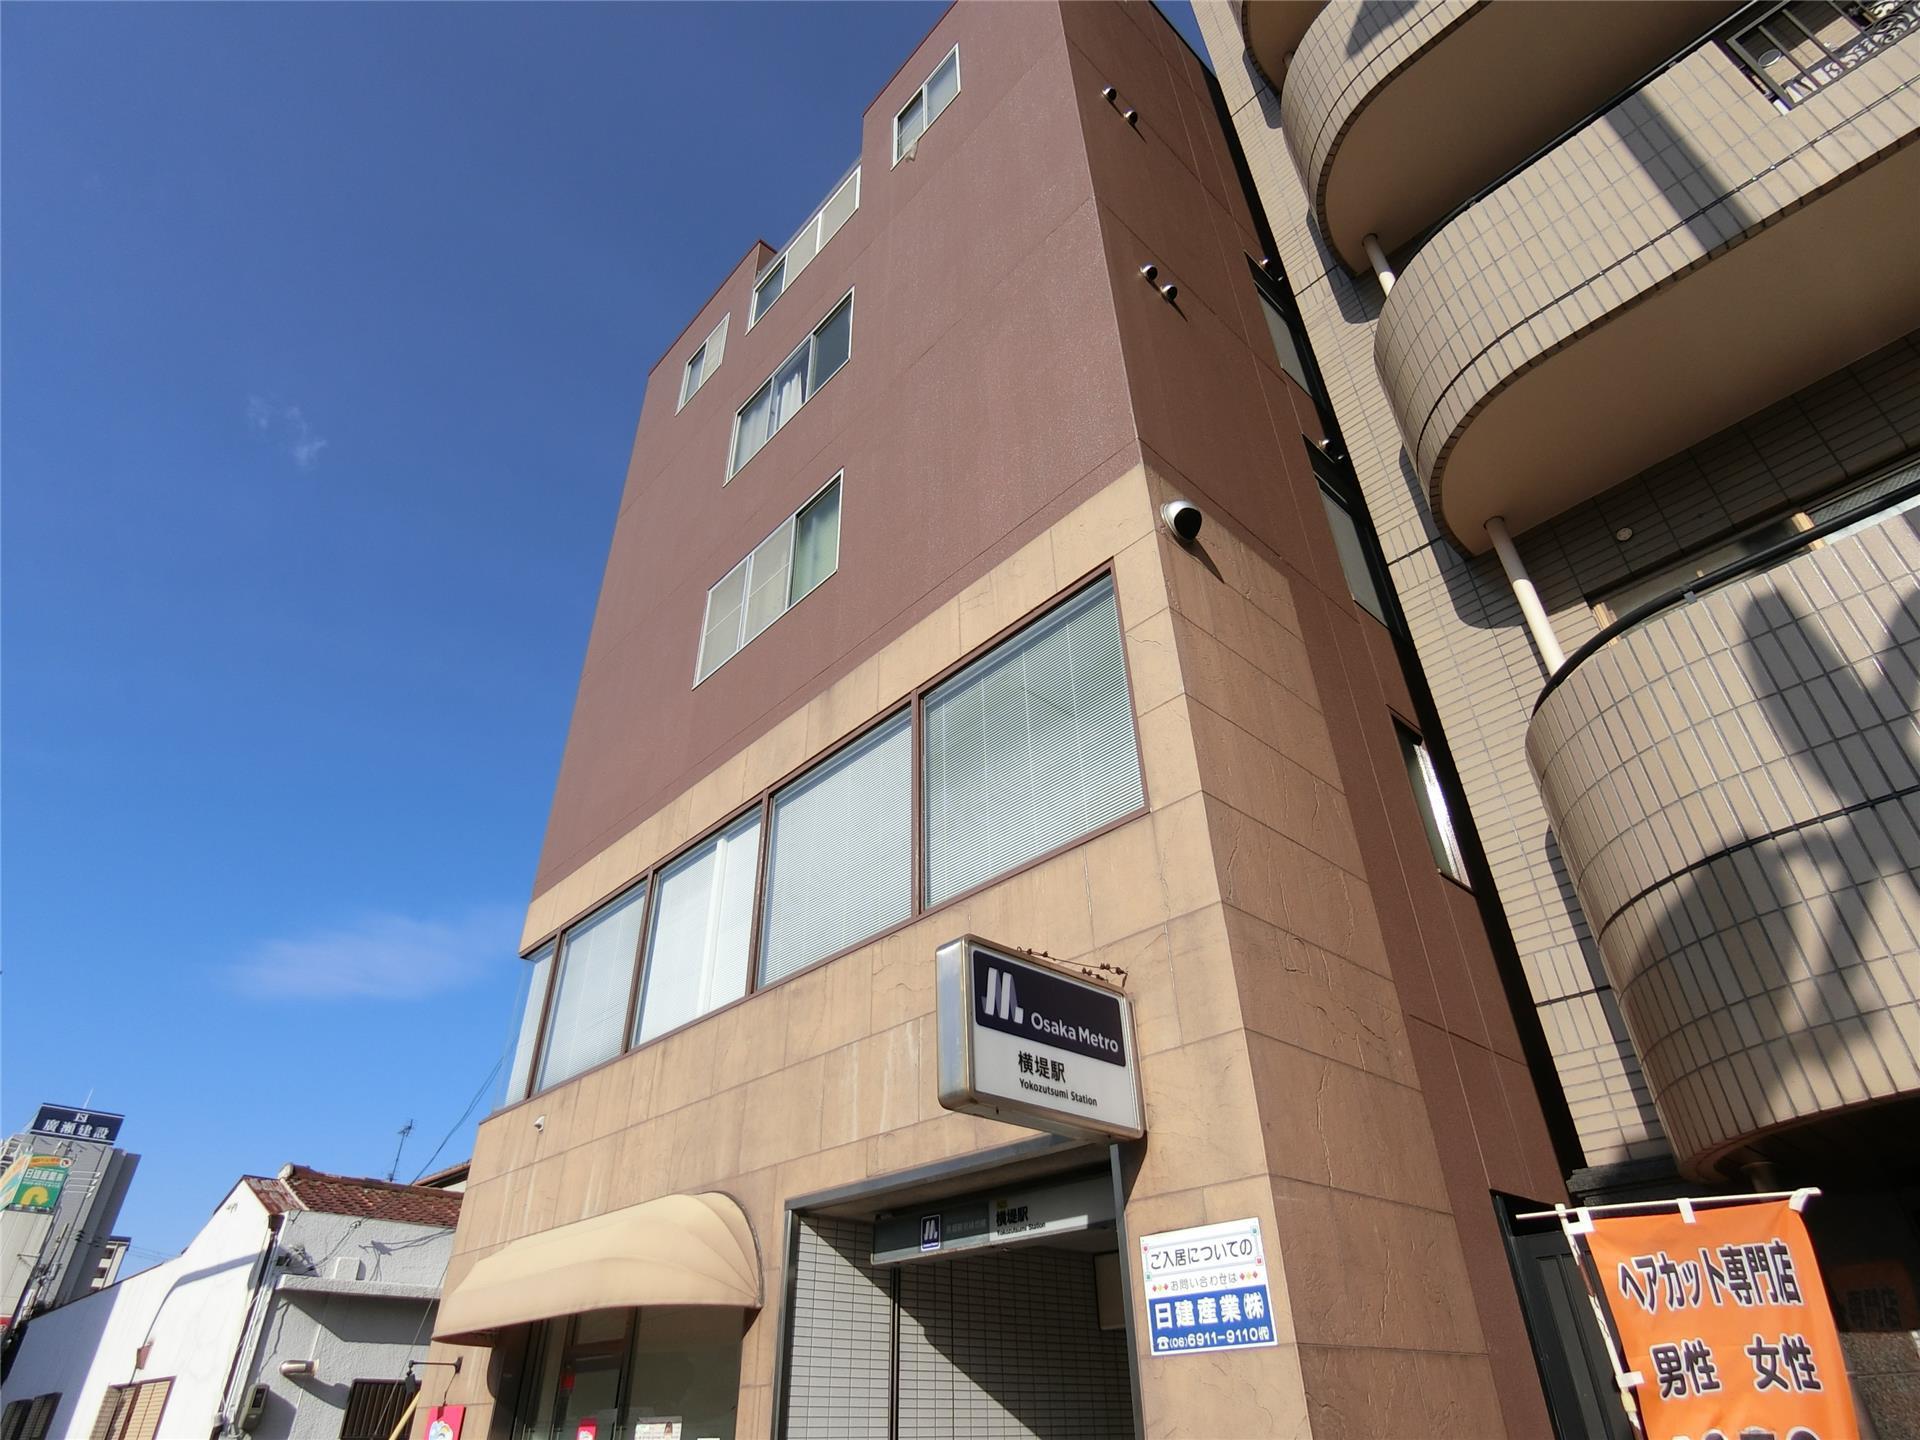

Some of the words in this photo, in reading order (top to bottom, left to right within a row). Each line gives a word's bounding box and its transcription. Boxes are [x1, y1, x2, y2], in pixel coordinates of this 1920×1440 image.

[1031, 1012, 1077, 1041] Osaka
[1078, 1026, 1119, 1053] Metro
[1018, 1050, 1066, 1083] 横堤駅
[1019, 1078, 1069, 1100] Yokozutsumi
[1070, 1091, 1098, 1106] Station
[996, 1205, 1029, 1227] 横堤駅
[1151, 1238, 1253, 1270] ご入居についての
[1170, 1272, 1238, 1292] お問い合わせは
[1618, 1239, 1804, 1313] ヘアカット専門店
[1651, 1338, 1722, 1399] 男性
[1746, 1334, 1823, 1392] 女性
